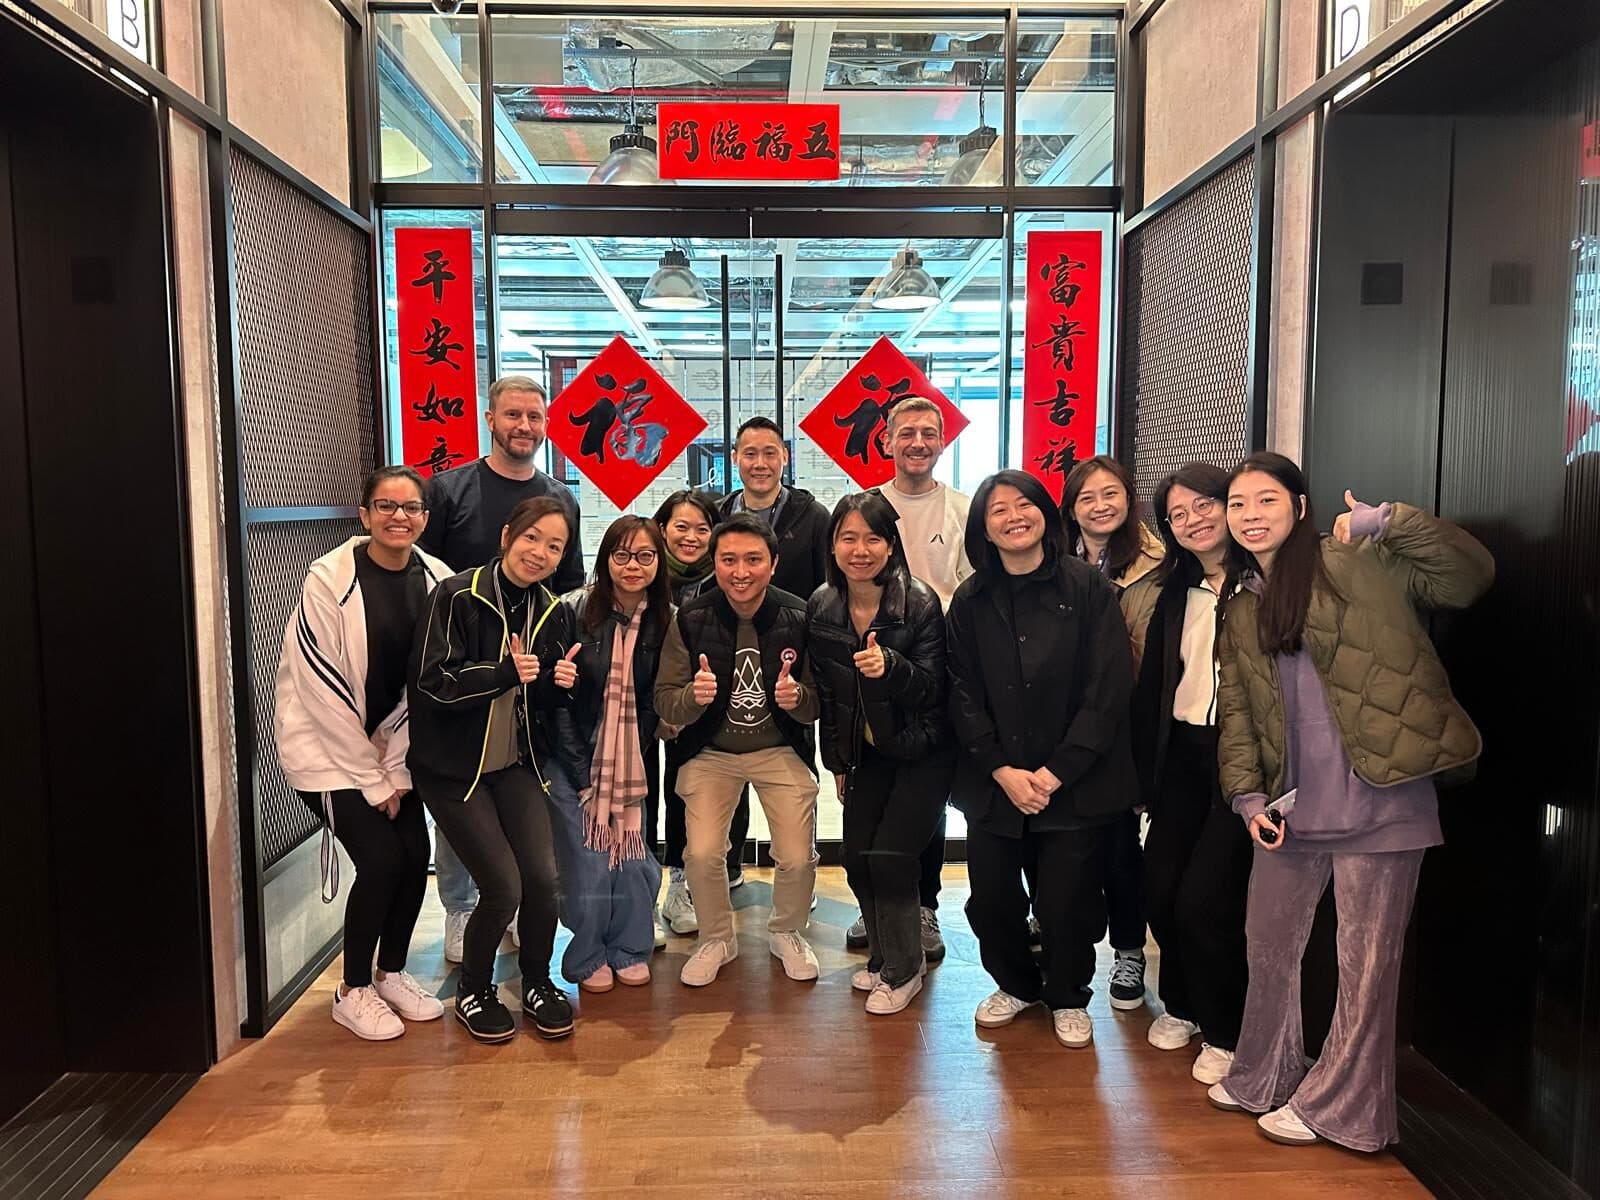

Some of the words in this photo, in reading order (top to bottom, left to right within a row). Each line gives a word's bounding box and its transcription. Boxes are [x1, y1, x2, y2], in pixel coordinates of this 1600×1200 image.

[121, 0, 140, 49] B
[1340, 4, 1361, 62] D
[1031, 253, 1088, 481] 富貴吉祥
[568, 372, 670, 468] 福
